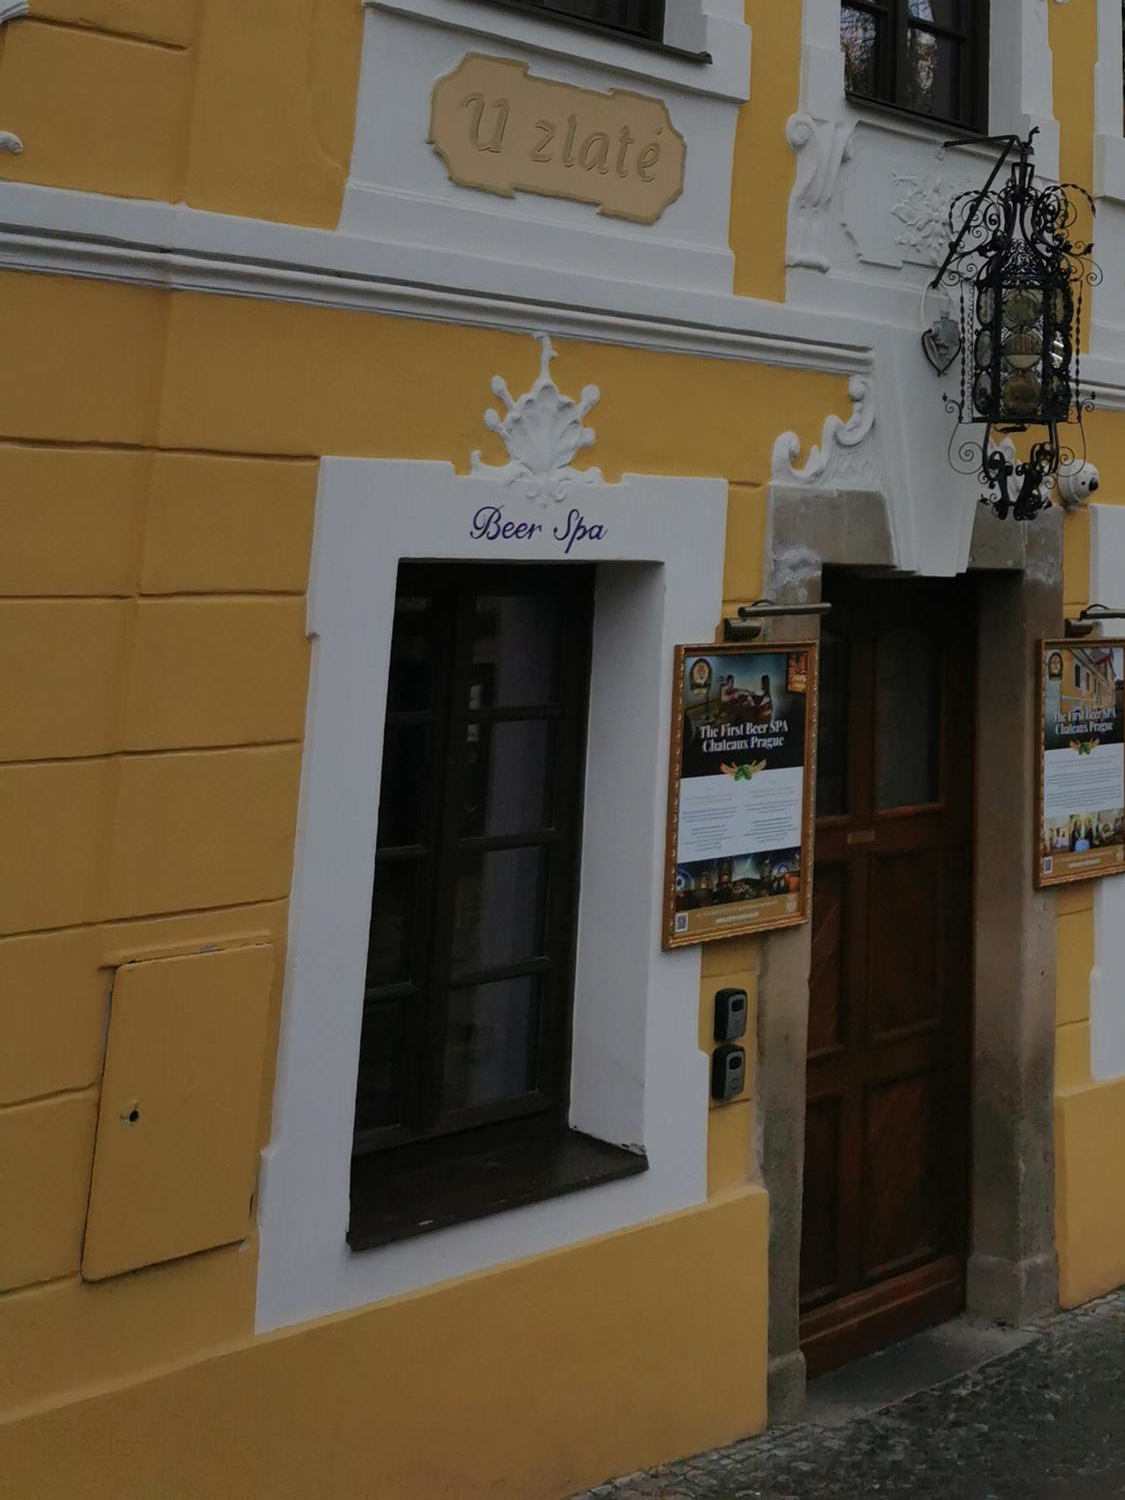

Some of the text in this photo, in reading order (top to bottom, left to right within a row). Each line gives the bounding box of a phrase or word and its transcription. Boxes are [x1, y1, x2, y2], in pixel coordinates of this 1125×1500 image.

[459, 92, 664, 182] U zlaté
[470, 504, 608, 554] Beer Spa
[700, 719, 789, 739] The First Beer SPA
[702, 736, 784, 753] Chateaux Prague
